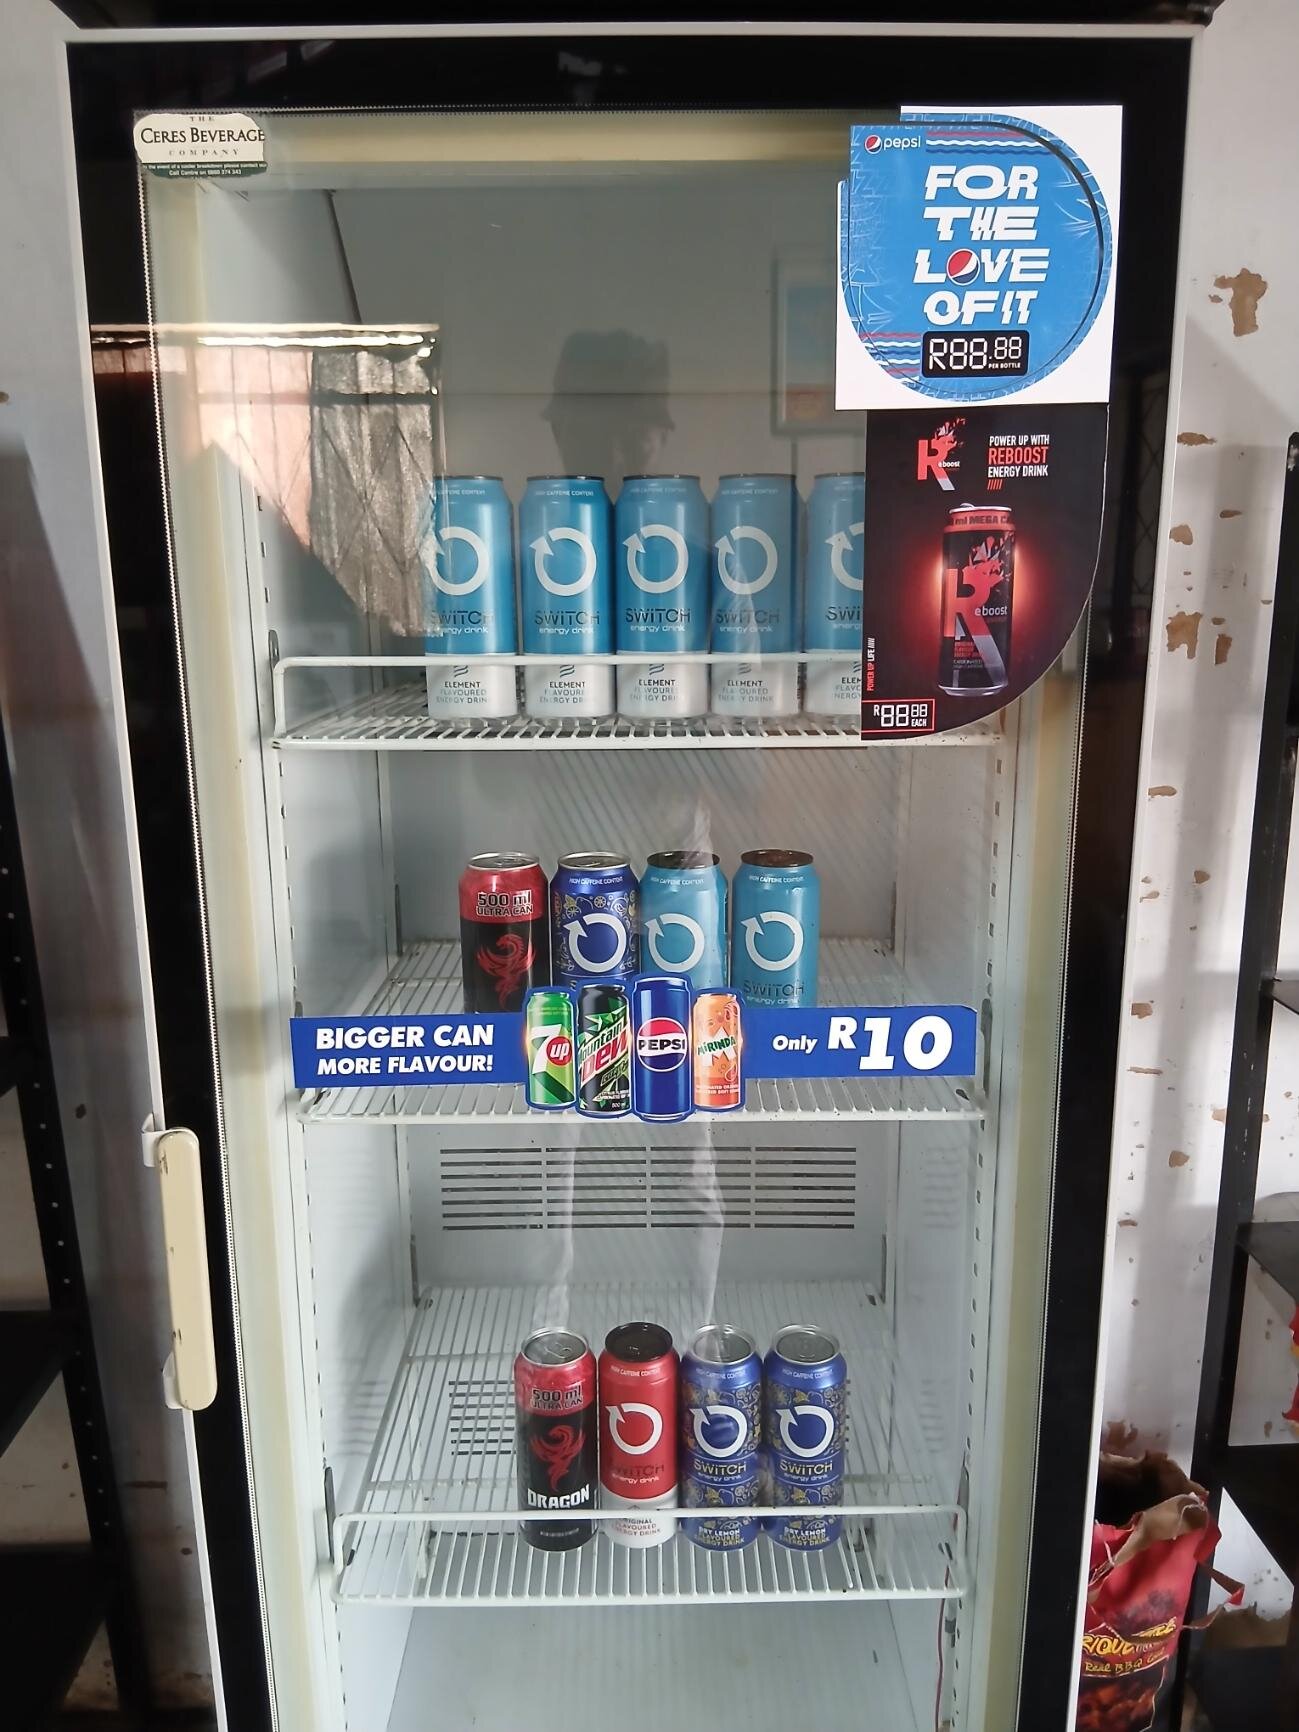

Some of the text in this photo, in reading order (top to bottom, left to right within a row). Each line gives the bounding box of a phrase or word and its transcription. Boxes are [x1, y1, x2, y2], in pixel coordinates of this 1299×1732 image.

[190, 127, 265, 142] BEVERAGE
[884, 135, 921, 151] pepsi
[924, 165, 1038, 200] FOR
[923, 206, 1039, 241] THE
[923, 290, 1038, 326] OF IT
[989, 434, 1050, 446] POWER UP WITH
[988, 446, 1049, 465] REBOOST
[987, 465, 1049, 478] ENERGY DRINK
[867, 648, 875, 661] LIFE
[444, 681, 481, 689] ELEMENT
[549, 681, 585, 689] ELEMENT
[638, 679, 676, 687] ELEMENT
[911, 718, 927, 727] EACH
[478, 889, 532, 908] 500 ml
[476, 903, 533, 917] ULTRA CAN
[316, 1023, 494, 1050] BIGGER CAN
[638, 1037, 686, 1051] PEPSI
[772, 1035, 818, 1055] Only
[317, 1053, 494, 1075] MORE FLAVOUR!
[532, 1382, 583, 1401] 500 ml
[694, 1458, 747, 1475] SWITCH
[780, 1458, 833, 1475] SWITCH
[527, 1484, 590, 1509] DRAGON
[714, 1528, 740, 1537] LEMON
[800, 1528, 826, 1537] LEMON
[1085, 1661, 1111, 1672] Real
